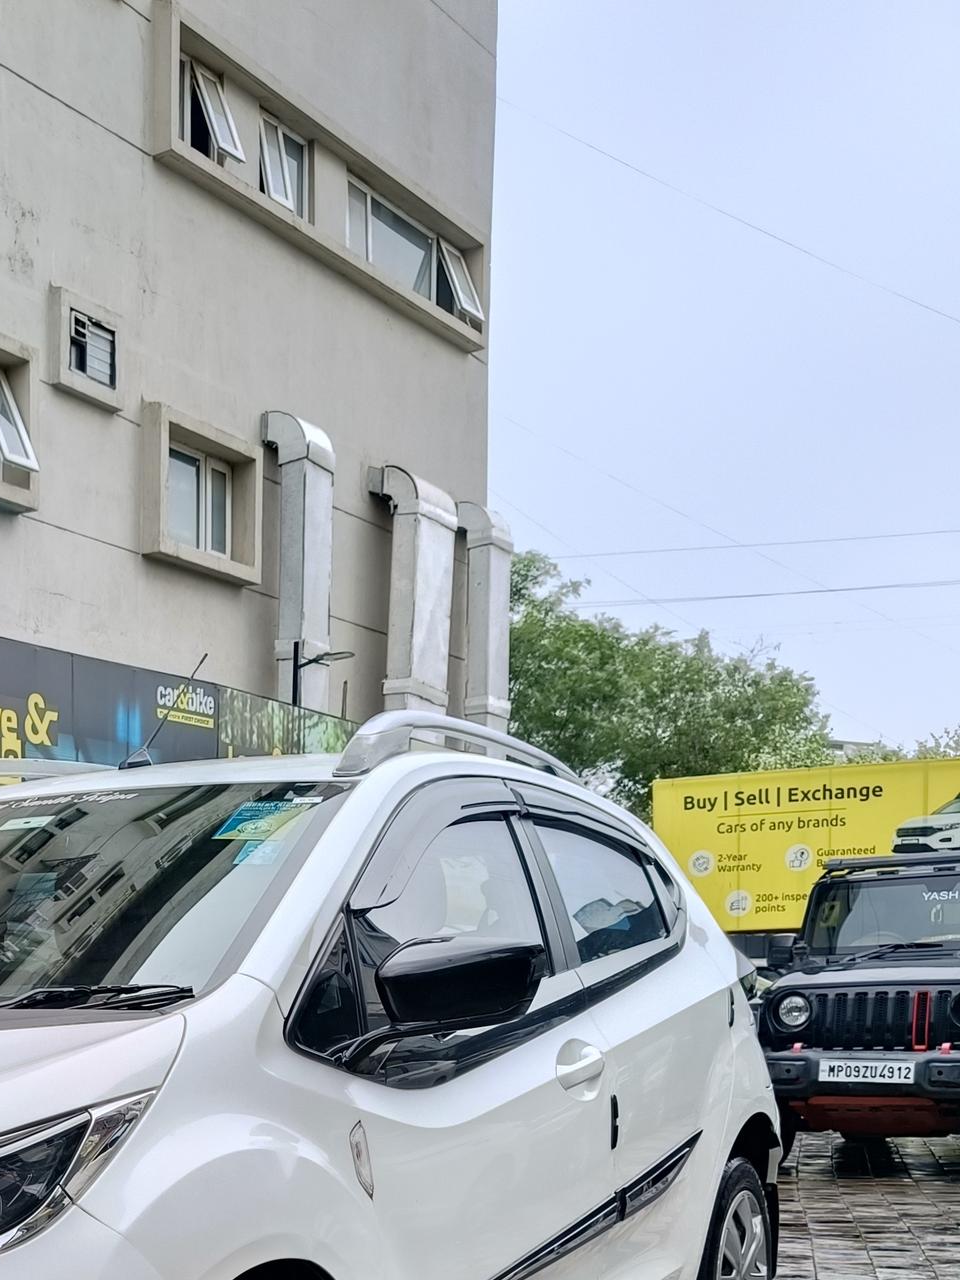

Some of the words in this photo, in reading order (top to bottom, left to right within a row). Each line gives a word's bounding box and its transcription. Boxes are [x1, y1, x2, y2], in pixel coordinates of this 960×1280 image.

[24, 692, 59, 746] &
[683, 796, 718, 812] Buy
[734, 788, 770, 807] Sell
[788, 784, 884, 803] Exchange
[717, 822, 747, 834] Cars
[750, 819, 765, 832] of
[769, 820, 793, 833] any
[797, 815, 846, 829] brands
[816, 846, 876, 857] Guaranteed
[717, 853, 748, 862] 2-Year
[717, 863, 762, 873] Warranty
[755, 894, 780, 903] 200+
[781, 892, 808, 903] inspe
[922, 891, 959, 900] YASH
[755, 904, 786, 914] points
[827, 1064, 912, 1080] MP09ZU4912
